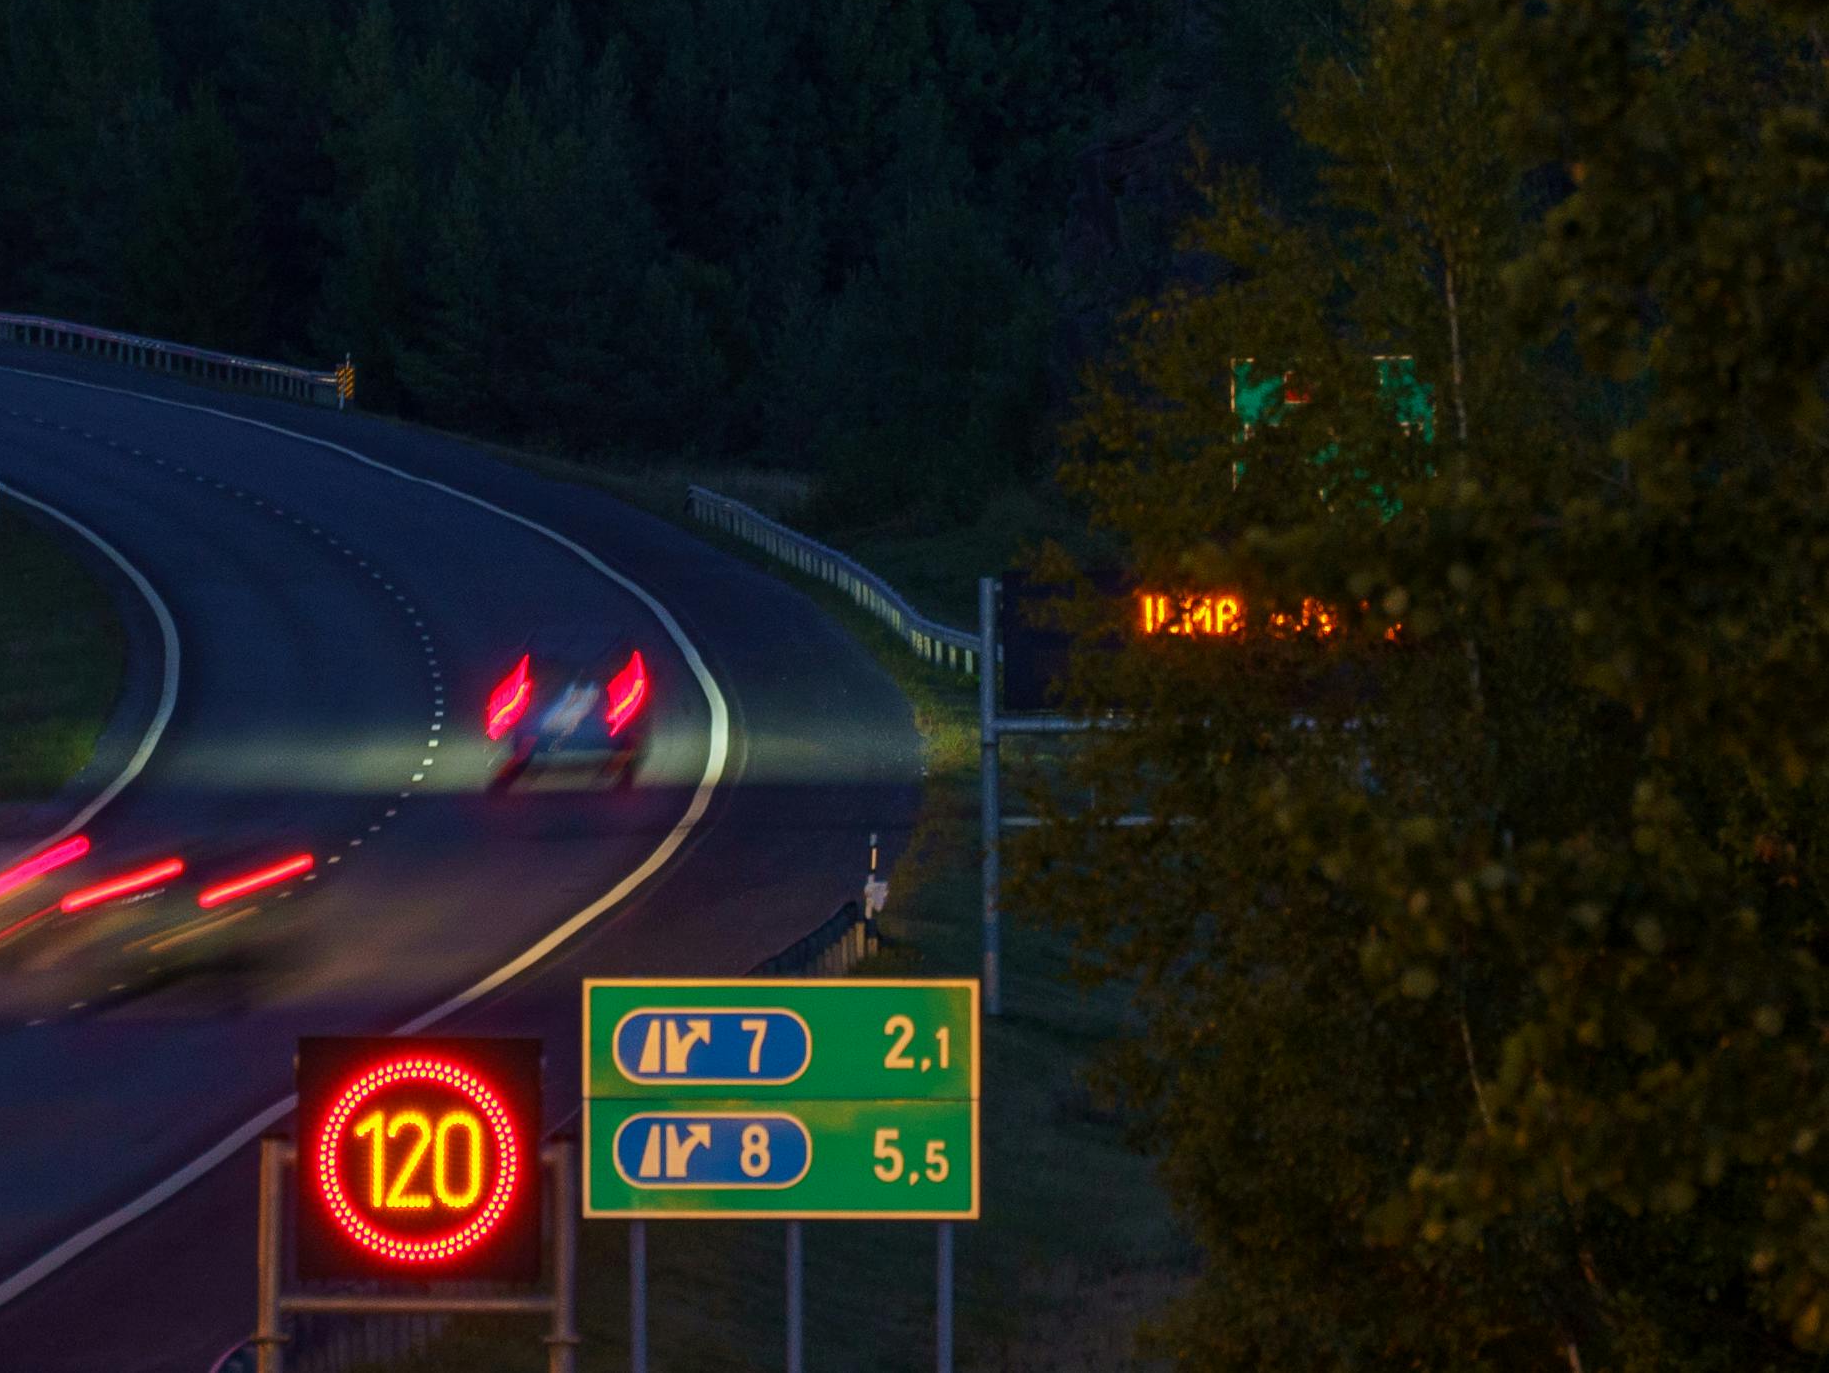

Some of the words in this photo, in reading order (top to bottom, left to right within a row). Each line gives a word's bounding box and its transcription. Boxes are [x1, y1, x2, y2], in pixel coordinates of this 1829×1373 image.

[741, 1019, 768, 1073] 7
[883, 1014, 950, 1073] 2,1
[355, 1111, 481, 1209] 120
[740, 1124, 771, 1178] 8
[873, 1128, 950, 1186] 5,5
